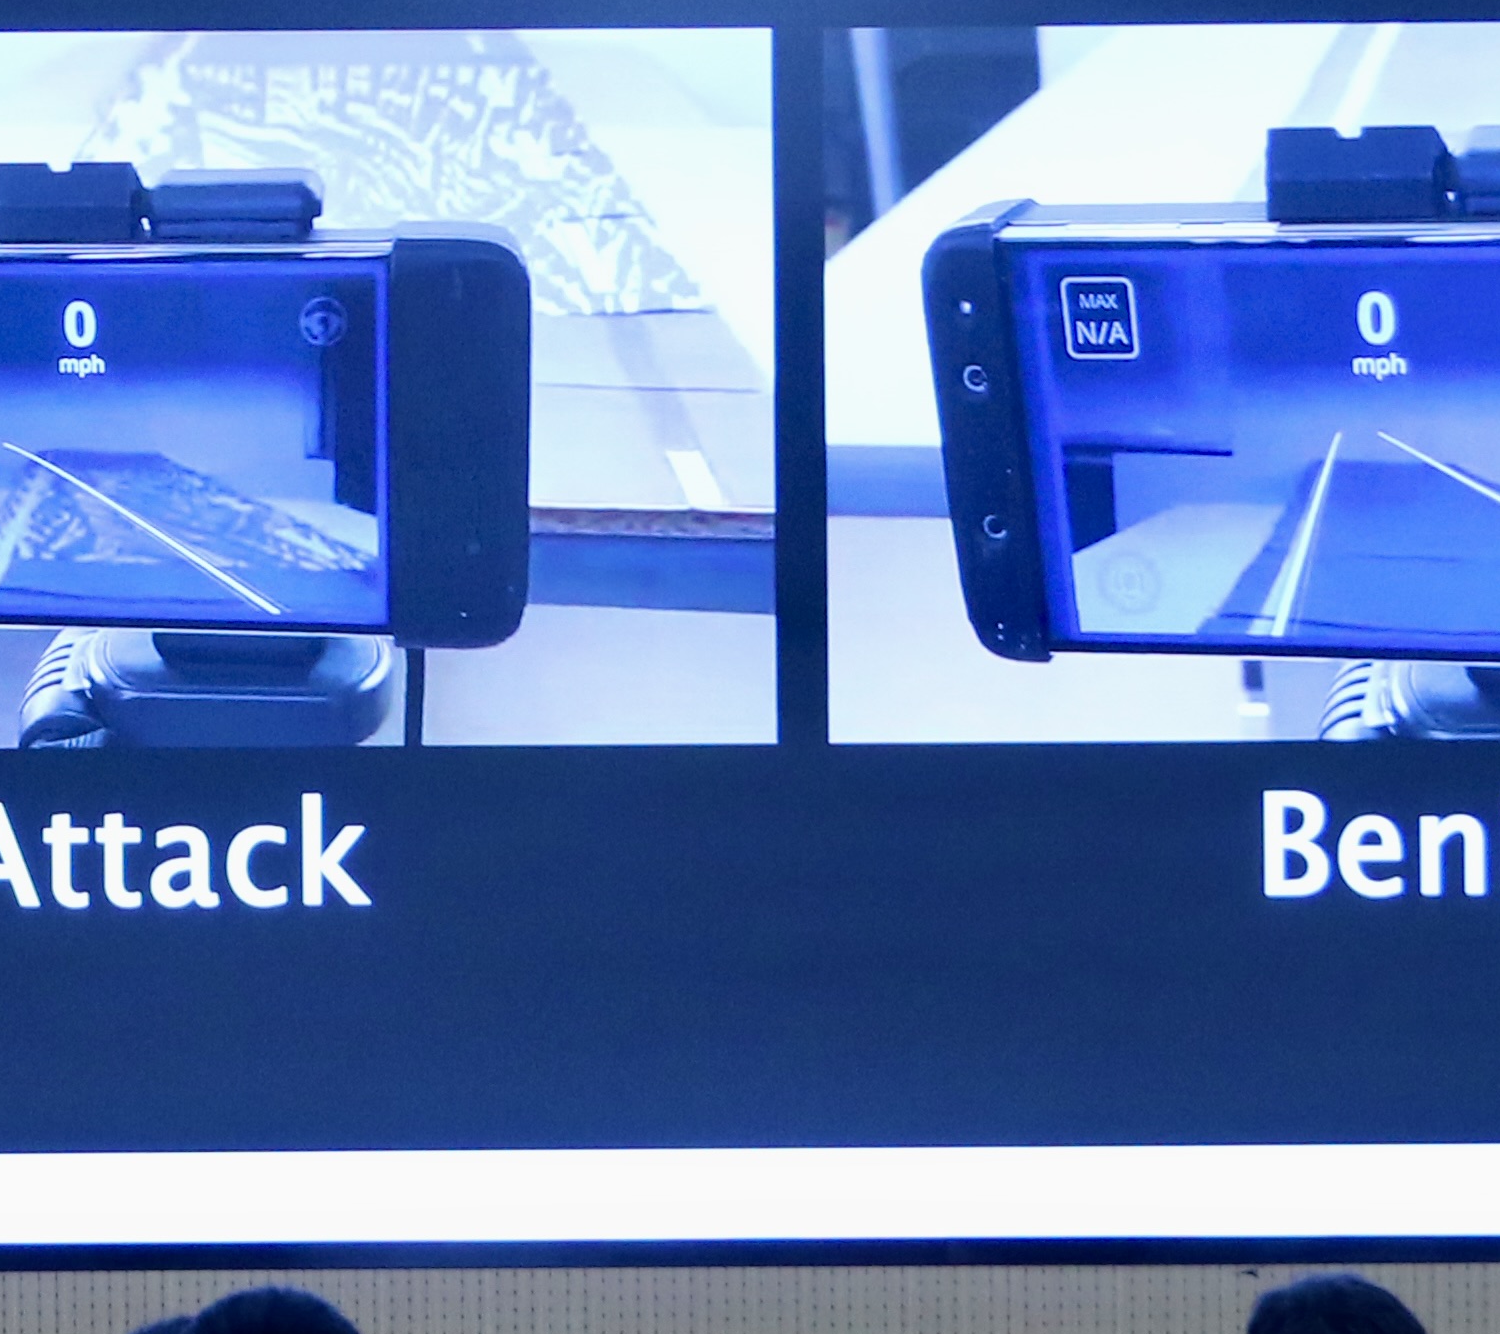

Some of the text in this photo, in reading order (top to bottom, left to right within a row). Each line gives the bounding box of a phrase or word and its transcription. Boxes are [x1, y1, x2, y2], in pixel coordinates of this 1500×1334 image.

[1078, 293, 1119, 309] MAX
[63, 300, 98, 348] 0
[1356, 290, 1396, 346] 0
[1075, 320, 1129, 345] N/A
[58, 353, 106, 379] mph
[1352, 352, 1407, 381] mph
